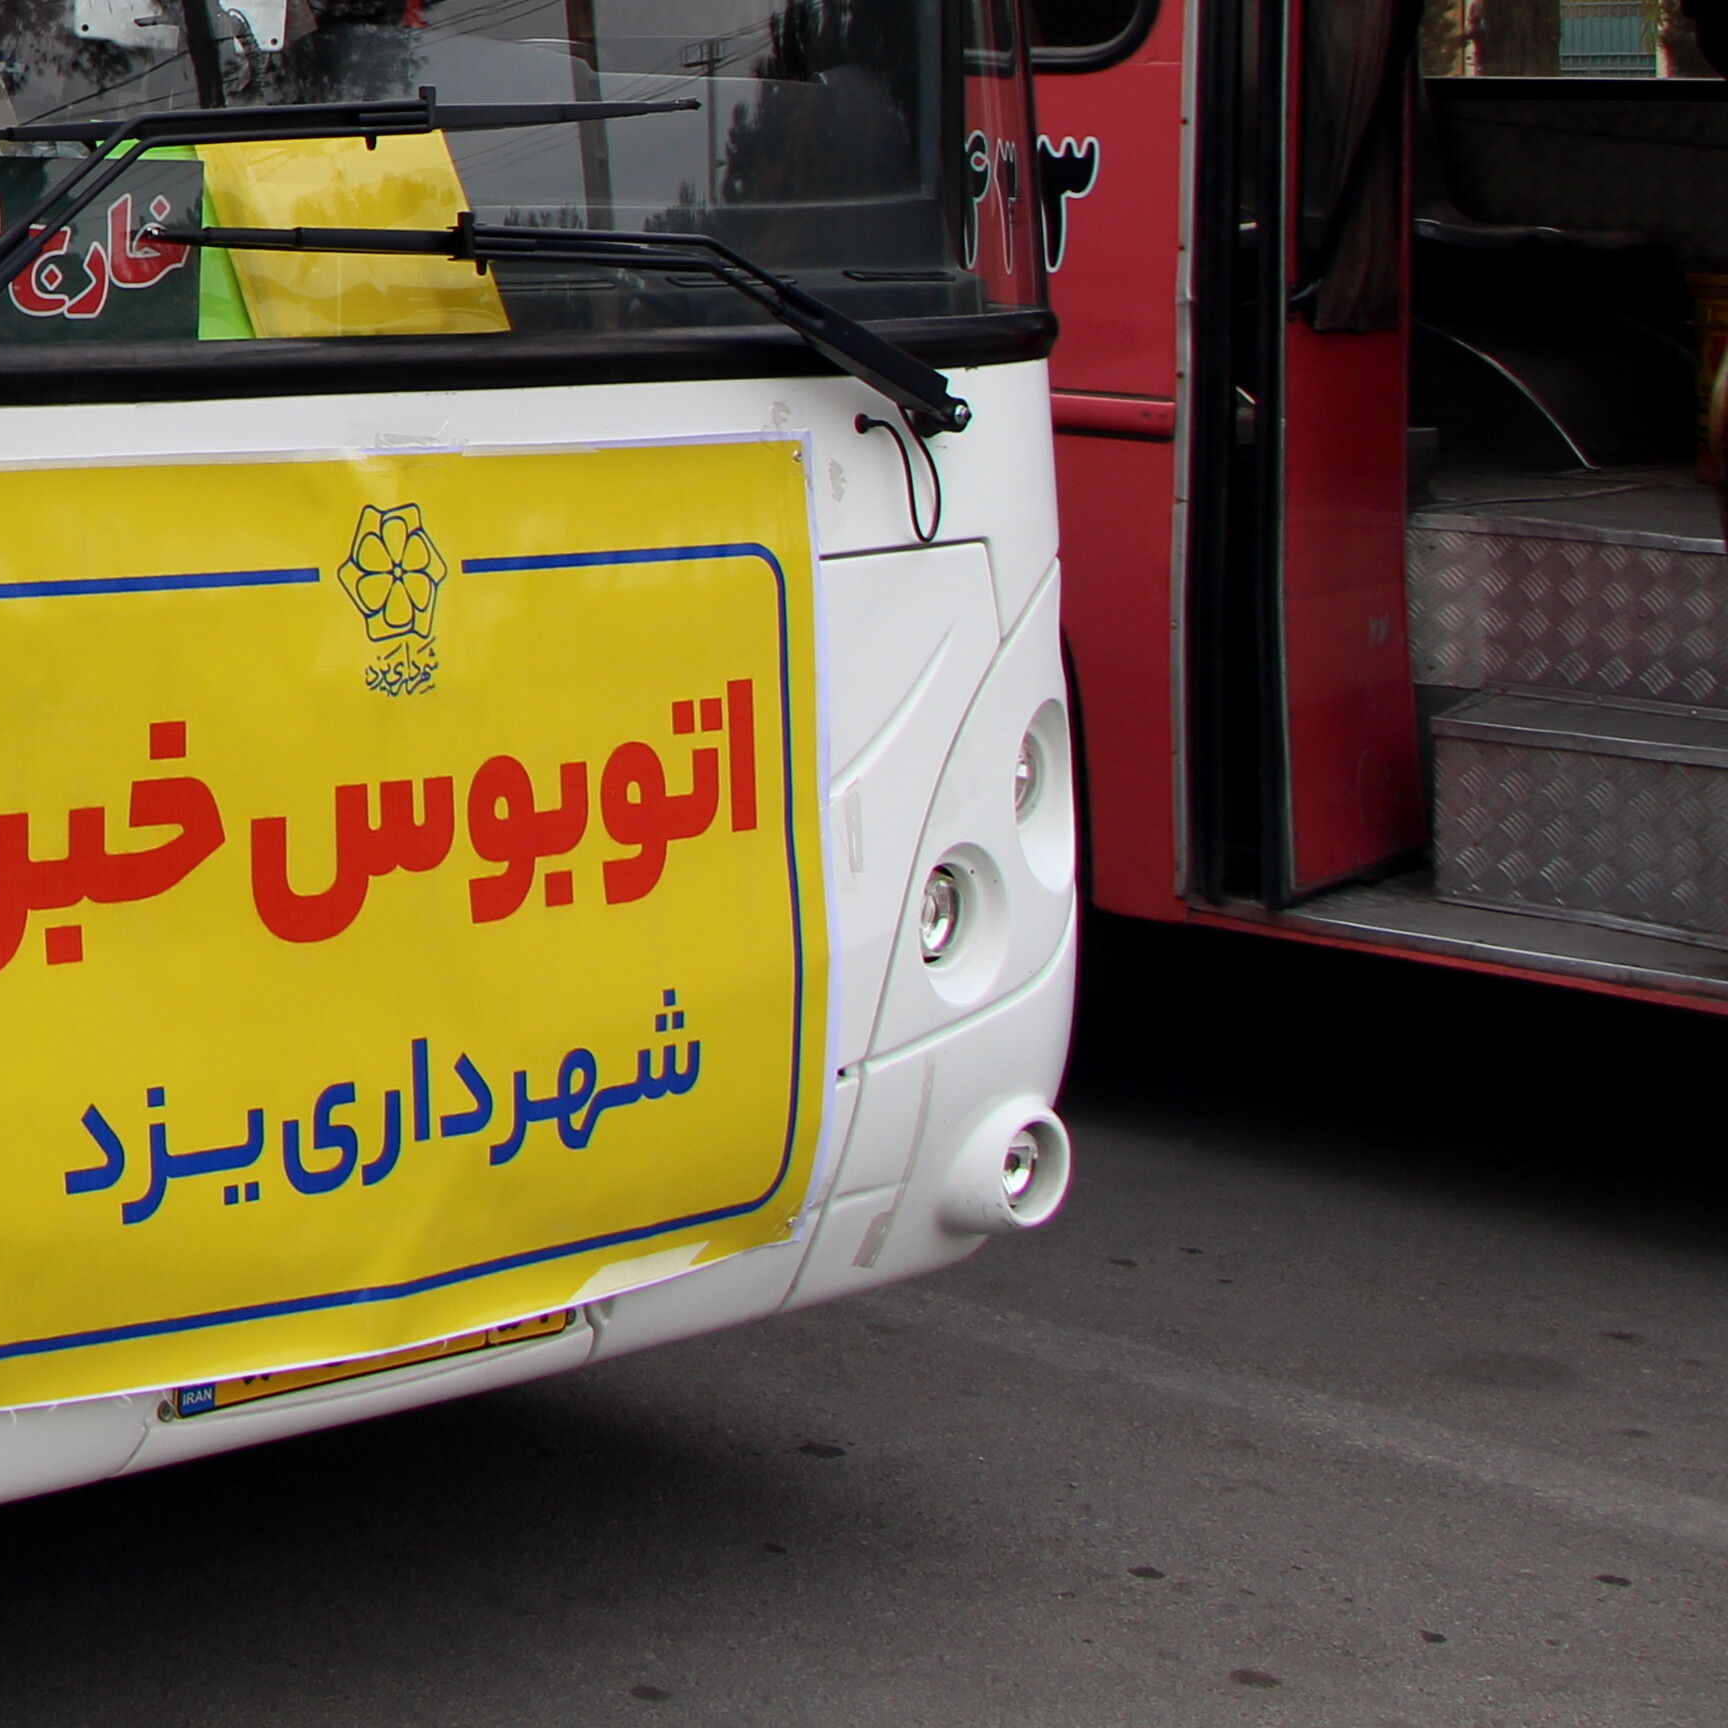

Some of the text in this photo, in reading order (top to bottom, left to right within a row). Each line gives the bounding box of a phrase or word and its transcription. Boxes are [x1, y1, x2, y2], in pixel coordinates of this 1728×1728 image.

[9, 193, 191, 319] خارج
[250, 678, 758, 944] اتوبوس
[64, 987, 701, 1226] شهرداری یزد
[181, 1387, 213, 1406] IRAN
